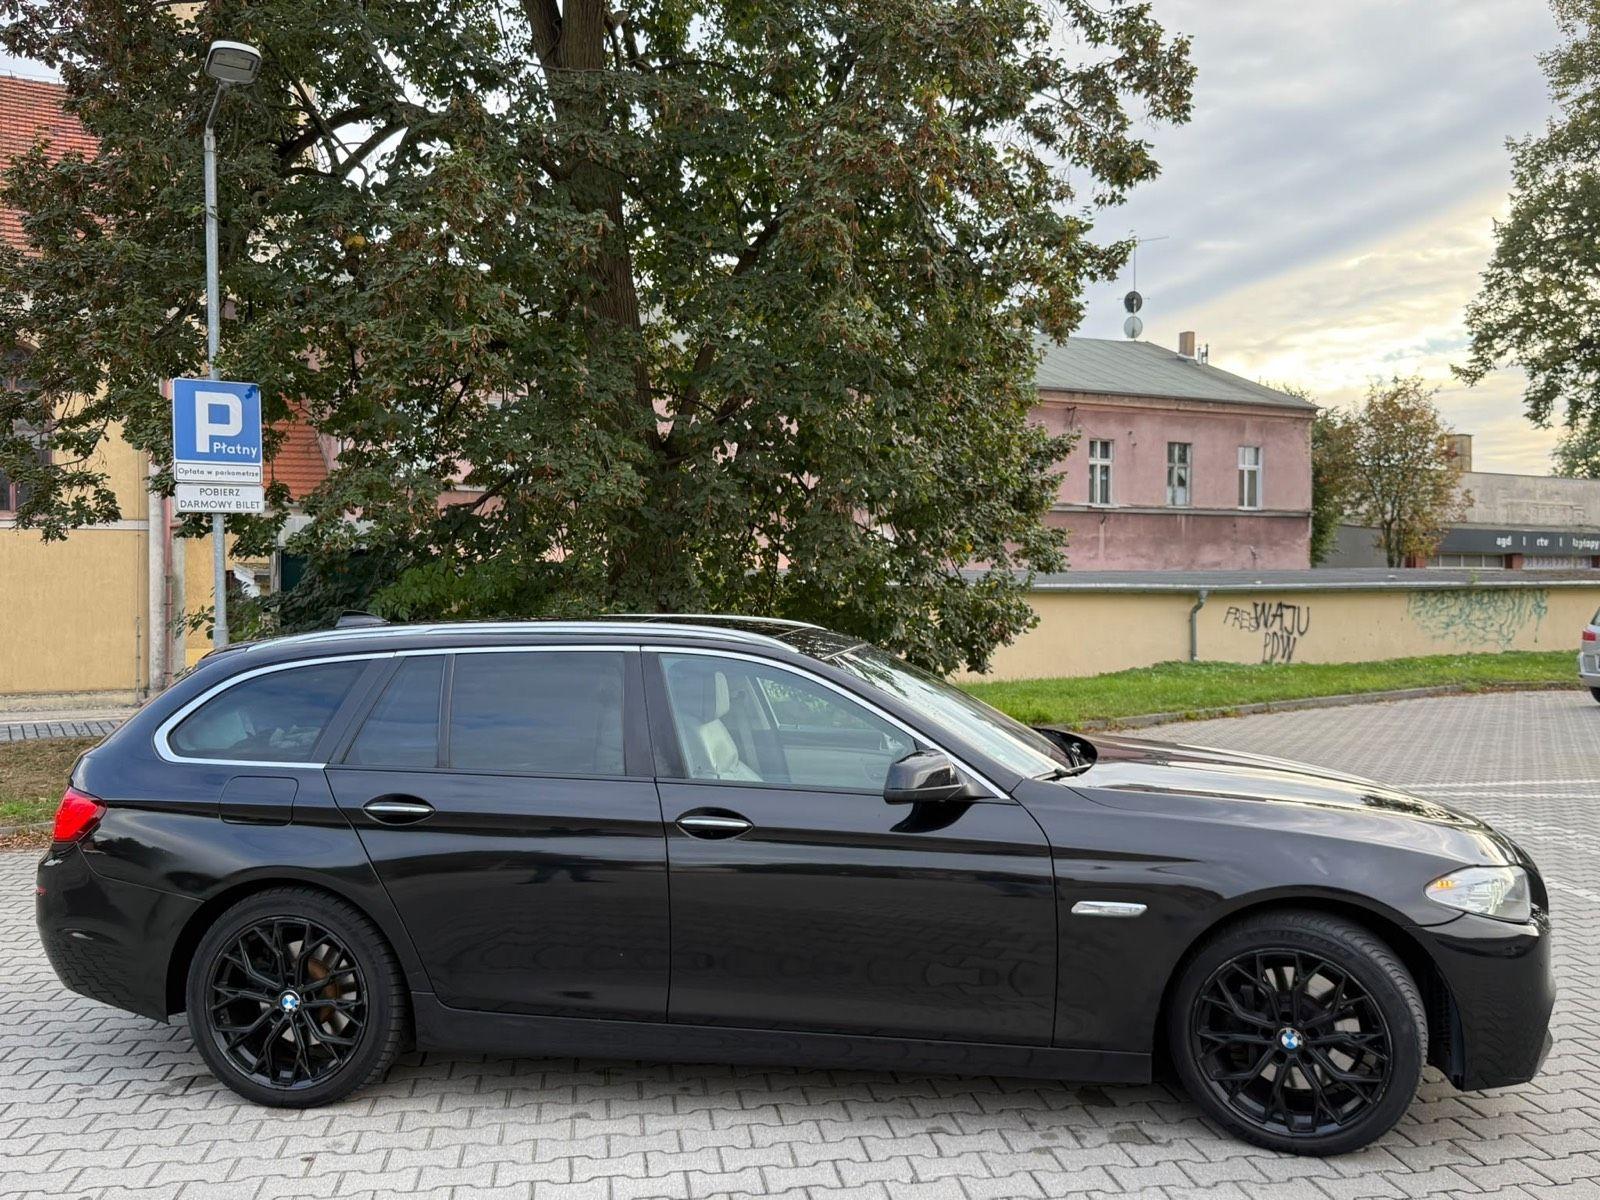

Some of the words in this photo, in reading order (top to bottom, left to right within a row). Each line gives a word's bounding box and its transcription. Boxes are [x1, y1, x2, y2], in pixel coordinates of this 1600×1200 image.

[195, 391, 242, 453] P
[213, 442, 258, 458] Płatny
[199, 488, 241, 497] POBIERZ
[180, 500, 232, 509] DARMOWY
[236, 502, 260, 510] BILET
